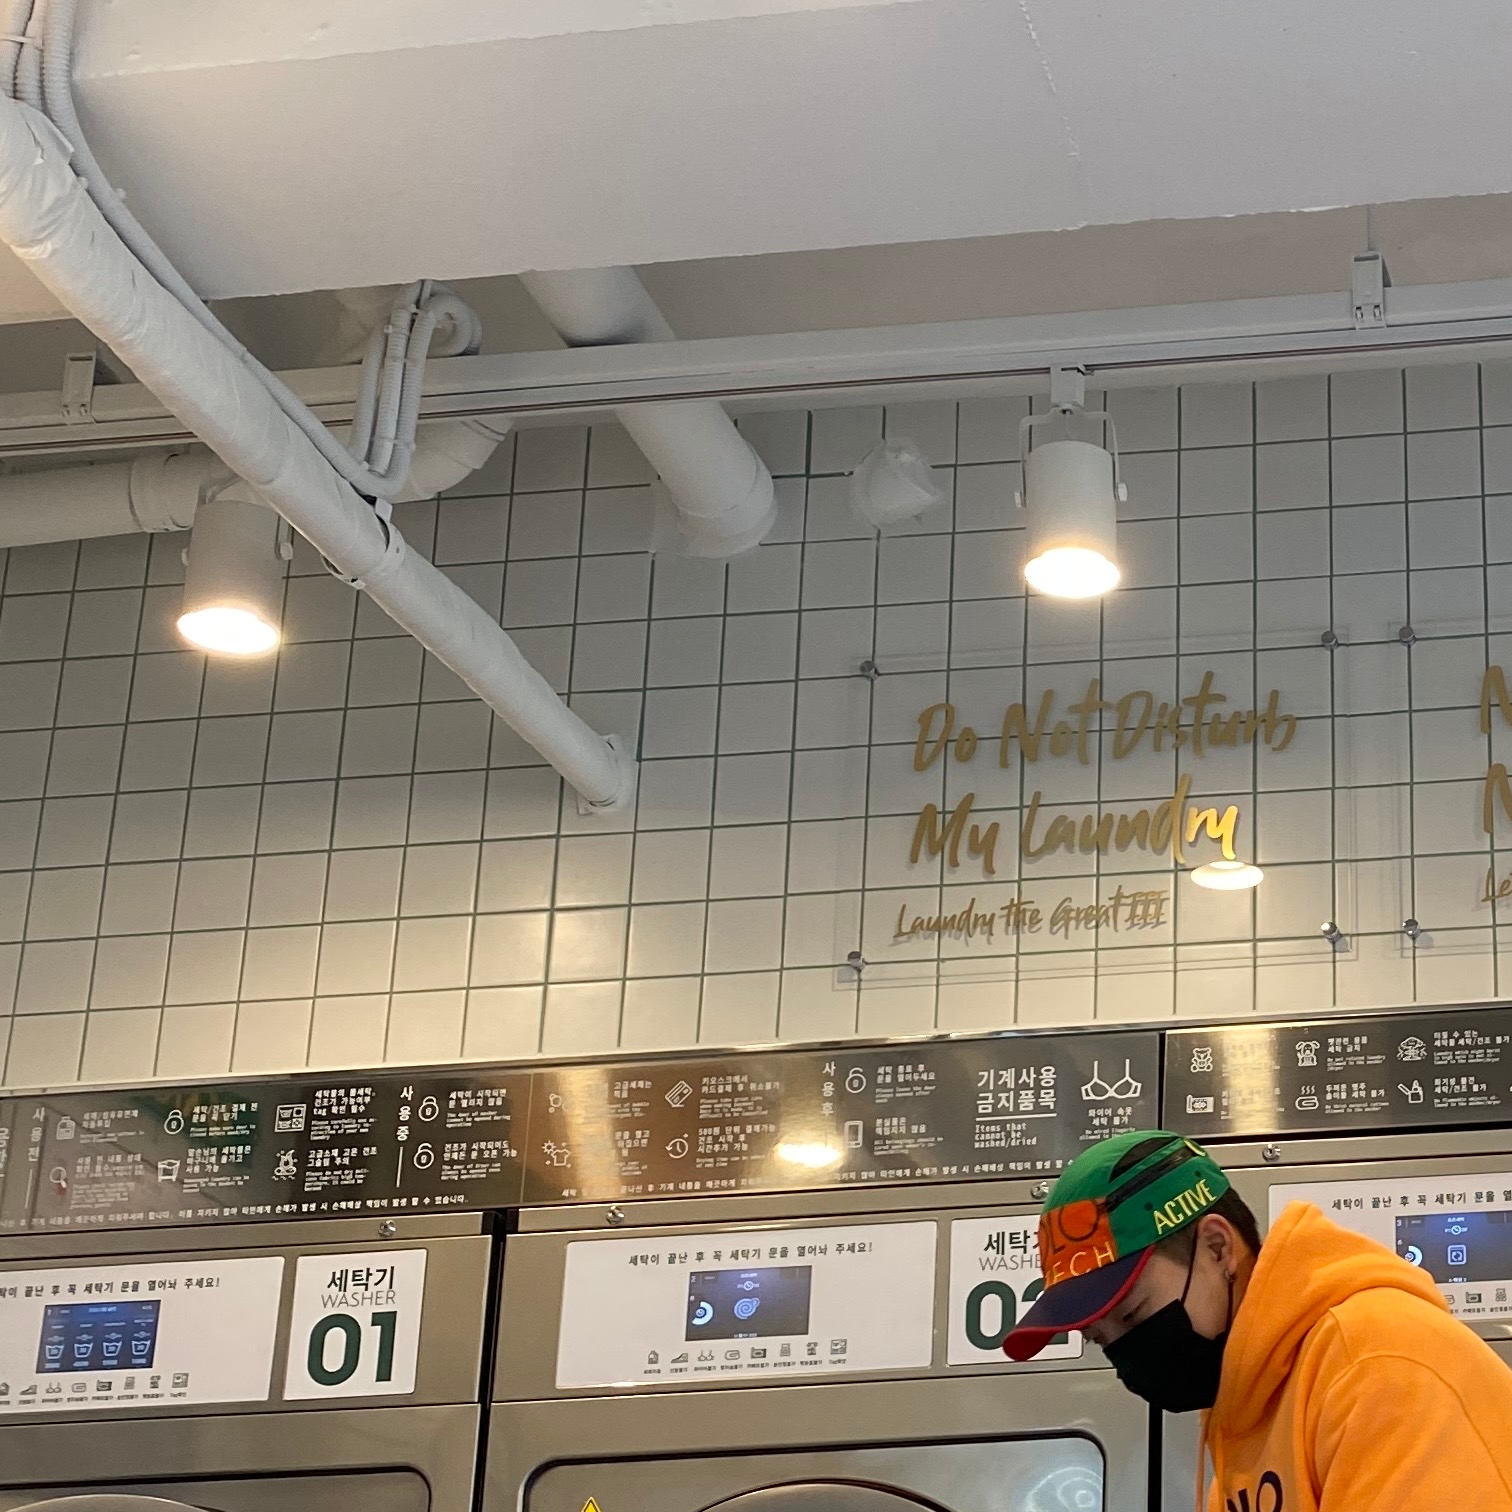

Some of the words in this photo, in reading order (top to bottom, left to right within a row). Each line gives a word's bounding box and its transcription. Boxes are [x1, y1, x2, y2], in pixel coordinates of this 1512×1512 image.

[913, 702, 978, 772] Do
[1000, 678, 1108, 768] Not
[1114, 671, 1297, 759] Disturb
[910, 793, 999, 875] My
[1022, 773, 1238, 866] Laundry
[893, 898, 995, 938] Laundry
[999, 891, 1042, 932] the
[1051, 885, 1129, 938] Great
[977, 1065, 1057, 1091] 기계사용
[976, 1089, 1057, 1113] 금지품목
[974, 1131, 1006, 1140] cannot
[1011, 1130, 1021, 1138] be
[975, 1124, 1001, 1132] Items
[1006, 1123, 1027, 1131] that
[974, 1137, 1037, 1148] washed/dried
[1153, 1178, 1217, 1236] ACTIVE
[1332, 1198, 1363, 1210] 세탁이
[1372, 1196, 1392, 1208] 끝난
[1400, 1195, 1410, 1206] 후
[1417, 1194, 1427, 1205] 꼭
[1435, 1192, 1466, 1205] 세탁기
[1474, 1191, 1495, 1203] 문을
[629, 1254, 660, 1266] 세탁이
[667, 1252, 688, 1264] 끝난
[695, 1251, 705, 1262] 후
[713, 1250, 722, 1261] 꼭
[730, 1248, 761, 1260] 세탁기
[769, 1247, 789, 1258] 문을
[835, 1241, 873, 1254] 주세요!
[979, 1254, 1041, 1272] WASHE
[1044, 1241, 1115, 1291] ECH
[25, 1285, 44, 1297] 끝난
[51, 1285, 60, 1296] 후
[84, 1282, 114, 1294] 세탁기
[120, 1281, 139, 1292] 문을
[184, 1277, 220, 1289] 주세요!
[326, 1266, 395, 1294] 세탁기
[321, 1290, 396, 1309] WASHER
[307, 1311, 397, 1387] 01
